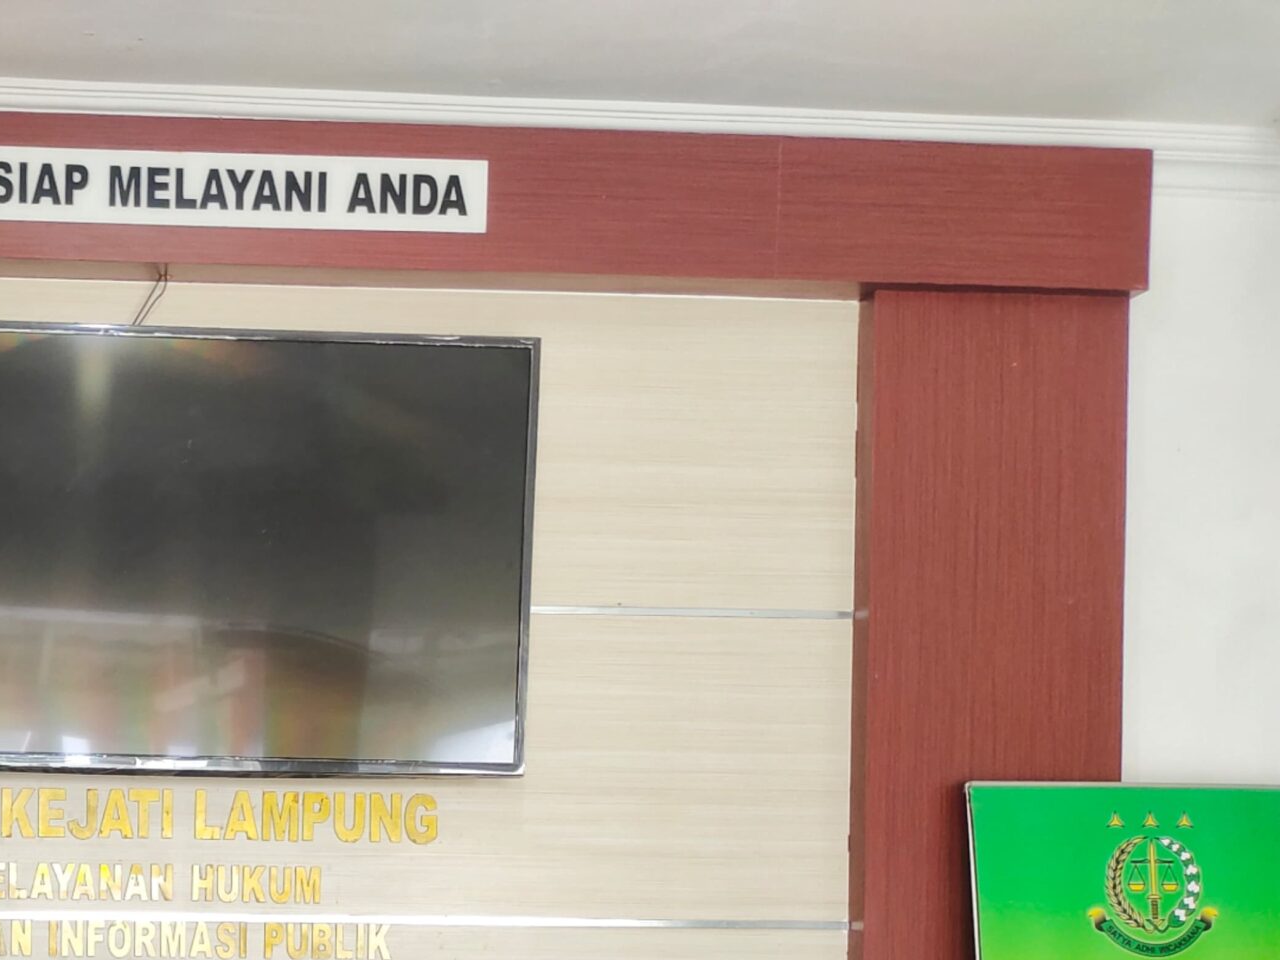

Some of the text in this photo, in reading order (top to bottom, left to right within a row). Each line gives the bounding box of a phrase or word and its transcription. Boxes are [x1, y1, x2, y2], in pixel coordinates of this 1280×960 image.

[108, 165, 328, 213] MELAYANI
[346, 172, 468, 216] ANDA
[0, 786, 173, 840] KEJATI
[194, 789, 439, 845] LAMPUNG
[191, 864, 322, 904] HUKUM
[48, 919, 247, 959] INFORMASI
[264, 922, 391, 960] PUBLIK
[1108, 925, 1132, 947] SATYA
